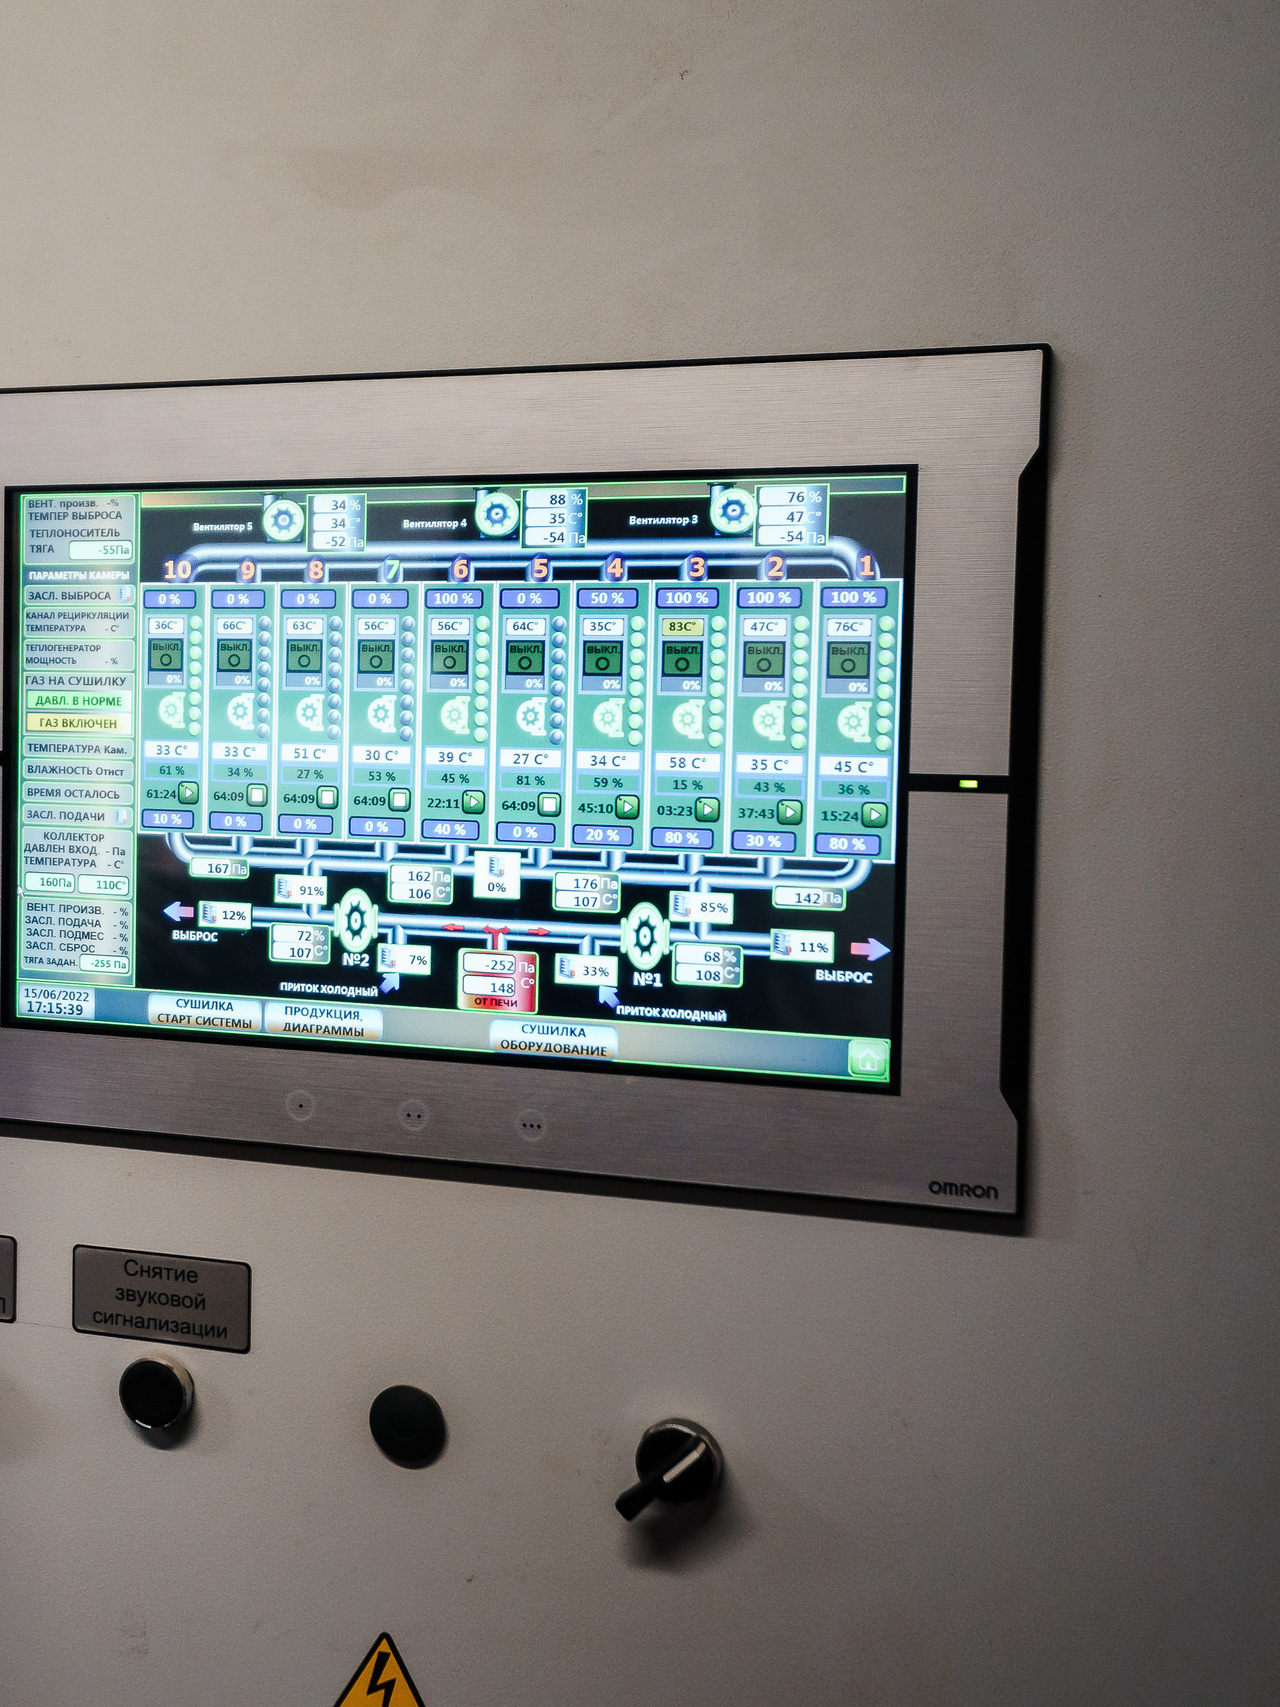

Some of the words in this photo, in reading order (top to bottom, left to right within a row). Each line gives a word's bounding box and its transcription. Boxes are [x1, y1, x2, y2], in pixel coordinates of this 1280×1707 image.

[550, 495, 566, 505] 88
[788, 492, 805, 502] 76
[29, 500, 56, 508] ВЕНТ.
[60, 500, 98, 509] произв.
[332, 500, 346, 510] 34
[28, 512, 68, 521] ТЕМПЕР
[72, 511, 122, 519] ВЫБРОСА
[549, 513, 565, 524] 35
[629, 516, 690, 526] Вентилятор
[691, 516, 698, 524] 3
[787, 512, 803, 522] 47
[193, 523, 244, 532] Вентилятор
[332, 518, 346, 528] 34
[403, 519, 458, 530] Вентилятор
[461, 519, 467, 528] 4
[30, 528, 120, 538] ТЕПЛОНОСИТЕЛЬ
[30, 545, 54, 553] ТЯГА
[164, 561, 191, 578] 10
[242, 561, 255, 579] 9
[309, 561, 323, 579] 8
[387, 560, 399, 579] 7
[453, 560, 468, 578] 6
[533, 559, 548, 577] 5
[608, 558, 622, 577] 4
[690, 558, 705, 576] 3
[768, 557, 783, 576] 2
[860, 556, 874, 575] 1
[29, 571, 87, 580] ПАРАМЕТРЫ
[90, 571, 129, 580] КАМЕРЫ
[29, 592, 58, 600] ЗАСЛ.
[62, 592, 111, 600] ВЫБРОСА
[58, 612, 129, 621] РЕЦИРКУЛЯЦИИ
[26, 657, 76, 666] МОЩНОСТЬ
[26, 676, 45, 685] ГАЗ
[49, 676, 65, 685] НА
[69, 677, 126, 686] СУШИЛКУ
[36, 696, 68, 706] ДАВЛ.
[73, 696, 79, 705] В
[83, 697, 122, 706] НОРМЕ
[40, 718, 58, 728] ГАЗ
[62, 718, 117, 728] ВКЛЮЧЕН
[28, 744, 101, 753] ТЕМПЕРАТУРА
[104, 746, 127, 754] Кам.
[28, 765, 92, 775] ВЛАЖНОСТЬ
[96, 767, 124, 776] Отнст
[28, 788, 61, 798] ВРЕМЯ
[65, 789, 119, 799] ОСТАЛОСЬ
[146, 790, 176, 799] 61:24
[213, 791, 244, 801] 64:09
[284, 794, 315, 804] 64:09
[353, 796, 386, 806] 64:09
[428, 798, 460, 808] 22:11
[502, 801, 535, 811] 64:09
[578, 803, 613, 813] 45:10
[658, 806, 693, 816] 03:23
[738, 808, 774, 819] 37:43
[27, 810, 56, 819] ЗАСЛ.
[60, 811, 104, 822] ПОДАЧИ
[822, 811, 859, 822] 15:24
[44, 832, 104, 842] КОЛЛЕКТОР
[24, 844, 65, 854] ДАВЛЕН
[69, 845, 100, 857] ВХОД.
[24, 857, 96, 868] ТЕМПЕРАТУРА
[207, 863, 228, 874] 167
[408, 871, 431, 882] 162
[487, 882, 506, 892] 0%
[573, 878, 598, 889] 176
[300, 886, 324, 896] 91%
[408, 889, 431, 899] 106
[573, 897, 598, 907] 107
[795, 893, 821, 904] 142
[27, 903, 55, 912] ВЕНТ.
[59, 905, 104, 915] ПРОИЗВ.
[700, 903, 728, 913] 85%
[222, 911, 246, 921] 12%
[25, 916, 55, 925] ЗАСЛ.
[59, 917, 101, 928] ПОДАЧА
[27, 929, 56, 937] ЗАСЛ.
[60, 930, 104, 940] ПОДМЕС
[173, 930, 218, 942] ВЫБРОС
[297, 931, 312, 941] 72
[26, 942, 56, 950] ЗАСЛ.
[60, 943, 95, 953] СБРОС
[289, 948, 311, 958] 107
[800, 942, 829, 953] 11%
[24, 956, 44, 965] ТЯГА
[46, 958, 78, 967] ЗАДАН.
[409, 955, 427, 965] 7%
[704, 951, 720, 962] 68
[583, 966, 609, 977] 33%
[696, 970, 721, 981] 108
[816, 969, 873, 984] ВЫБРОС
[280, 982, 319, 994] ПРИТОК
[320, 983, 378, 997] ХОЛОДНЫЙ
[490, 983, 514, 994] 148
[24, 988, 89, 1002] 15/06/2022
[28, 1001, 83, 1015] 17:15:39
[176, 999, 233, 1012] СУШИЛКА
[491, 999, 518, 1008] ПЕЧИ
[616, 1005, 660, 1017] ПРИТОК
[662, 1008, 727, 1022] ХОЛОДНЫЙ
[158, 1013, 192, 1024] СТАРТ
[195, 1016, 252, 1029] СИСТЕМЫ
[283, 1022, 364, 1037] ДИАГРАММЫ
[522, 1024, 586, 1038] СУШИЛКА
[501, 1040, 607, 1056] ОБОРУДОВАНИЕ
[928, 1180, 998, 1200] OMRON
[124, 1259, 199, 1283] Снятие
[116, 1285, 206, 1311] звуковой
[93, 1309, 228, 1339] сигнализации
